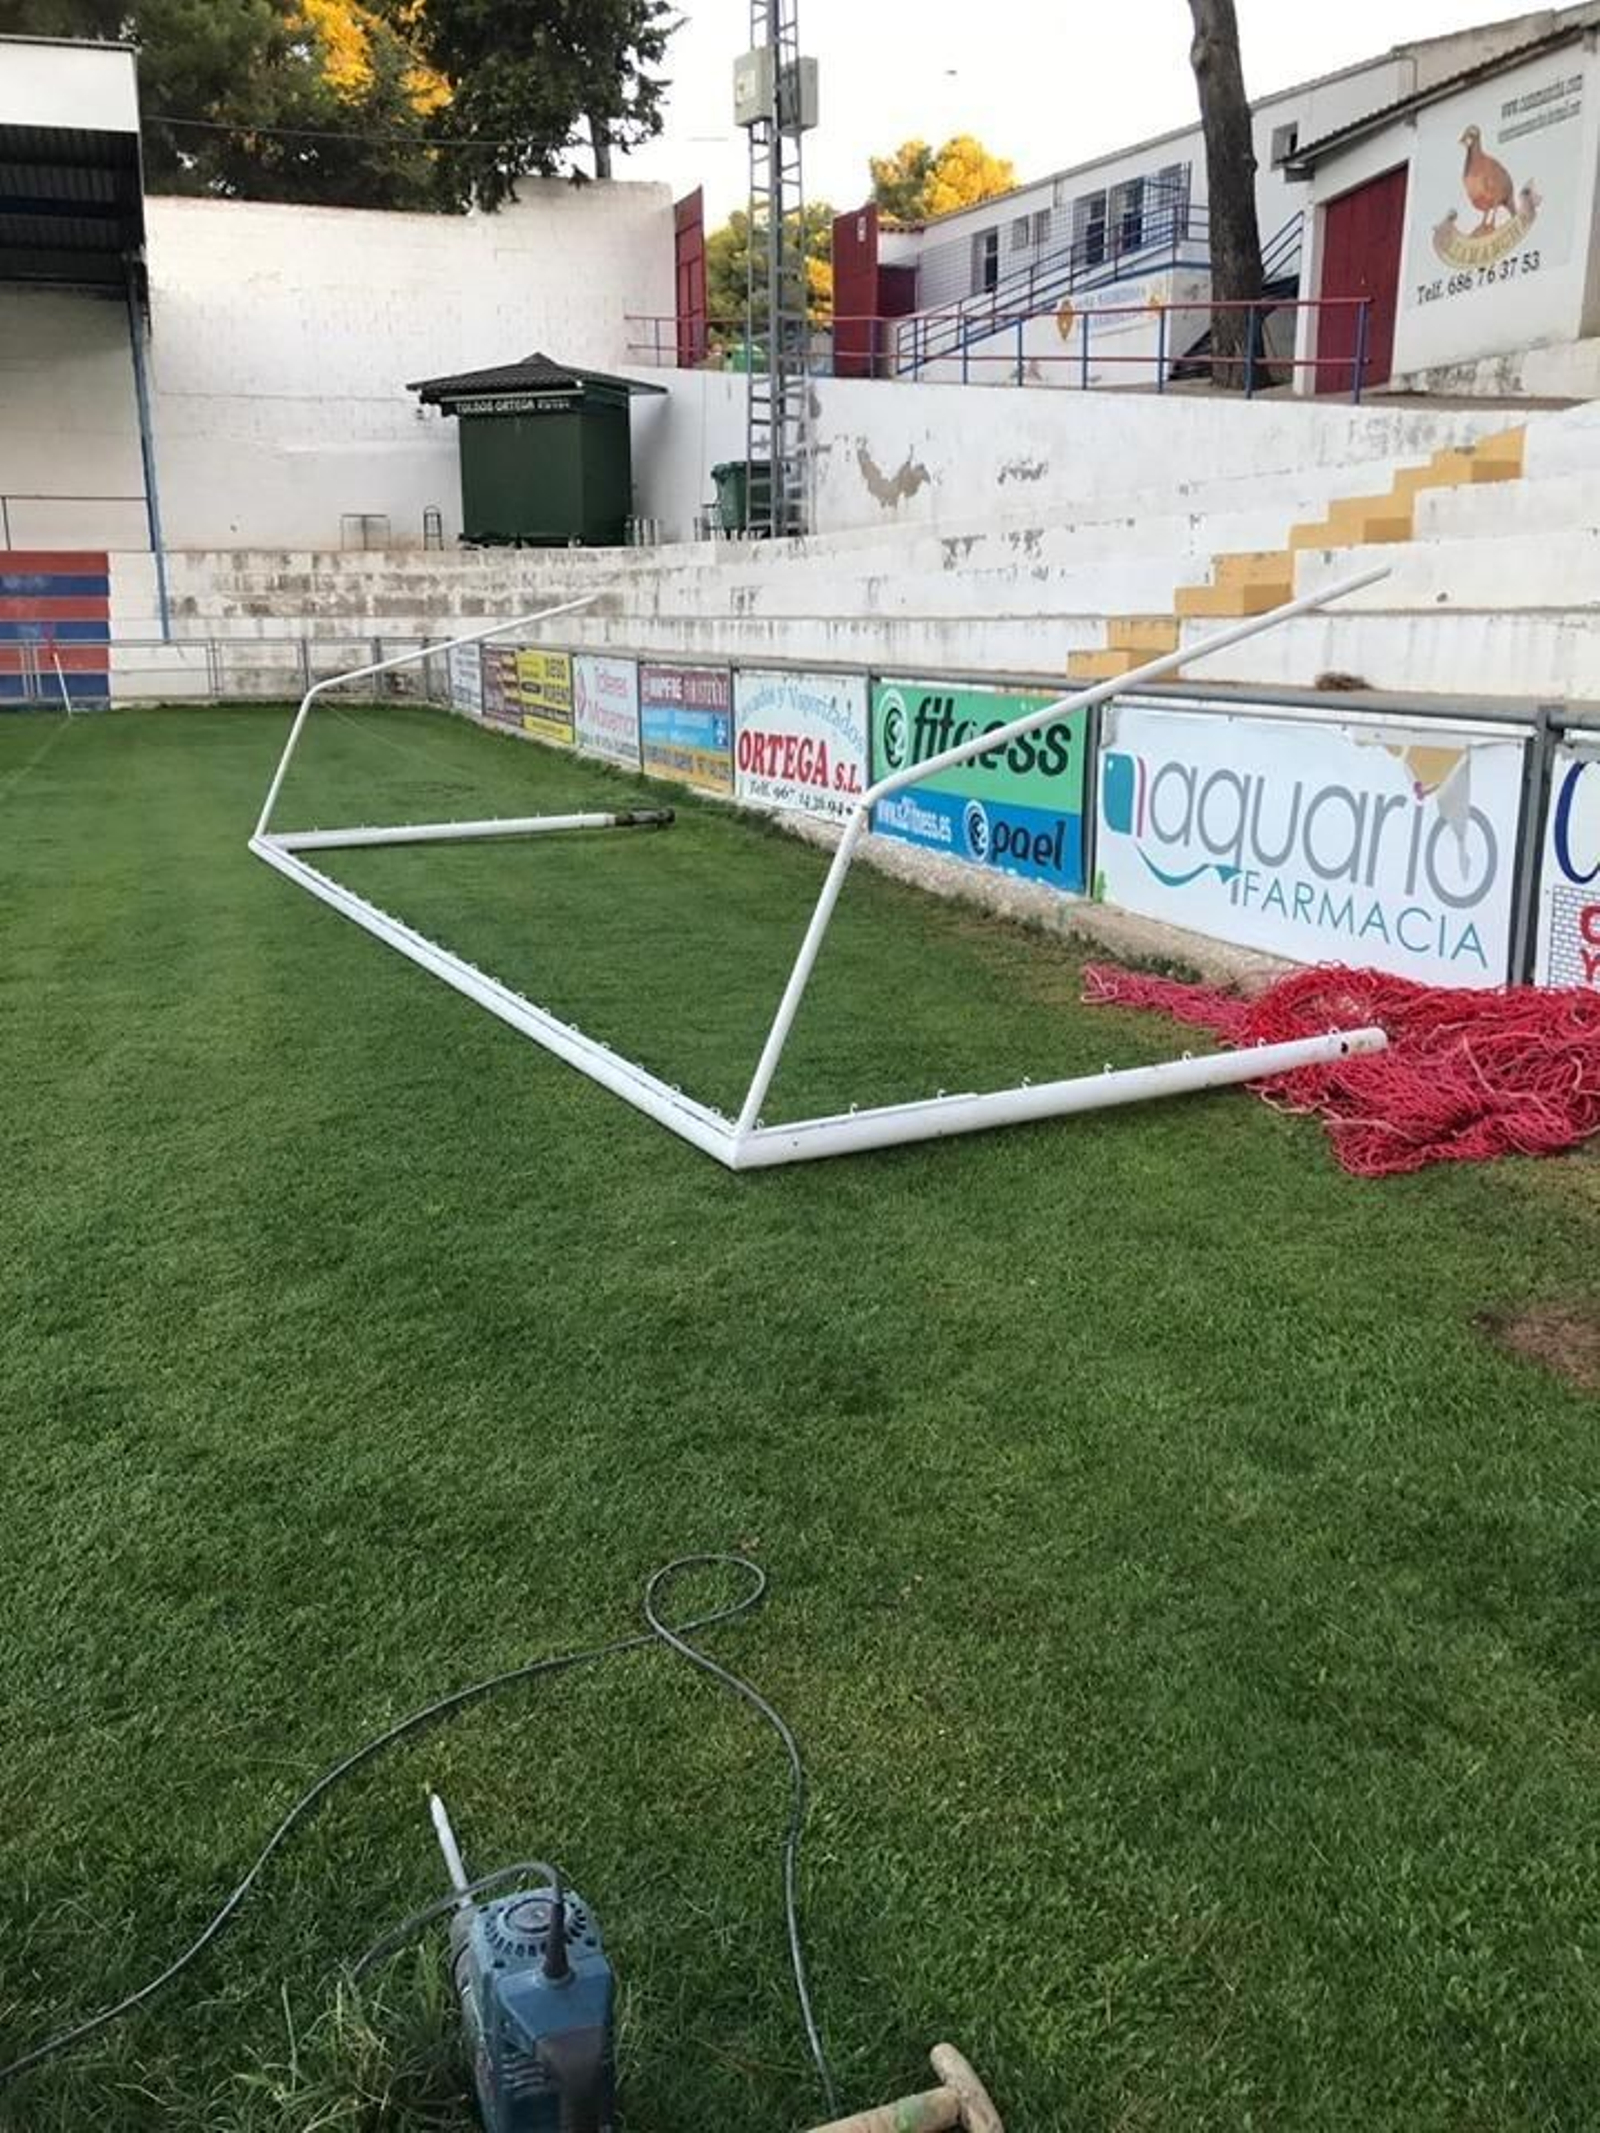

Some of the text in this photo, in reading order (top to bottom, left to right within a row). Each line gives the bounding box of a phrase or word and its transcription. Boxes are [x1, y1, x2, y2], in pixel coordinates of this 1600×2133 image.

[1448, 271, 1473, 296] 686
[1478, 265, 1496, 287] 76
[1500, 256, 1519, 280] 37
[1521, 250, 1541, 275] 53
[738, 728, 829, 788] ORTEGA
[1149, 761, 1499, 910] aquario
[1241, 869, 1489, 970] FARMACIA
